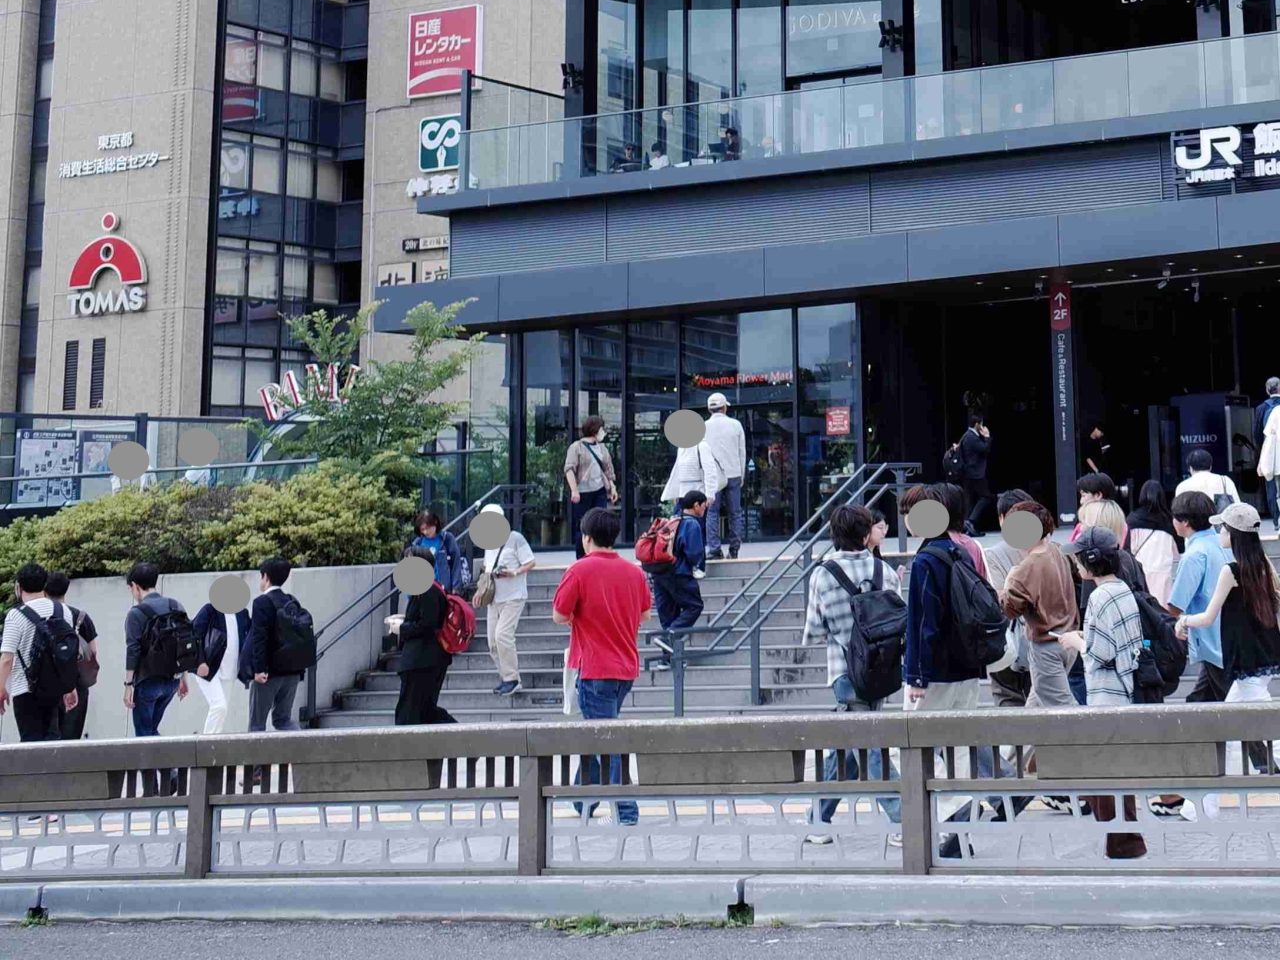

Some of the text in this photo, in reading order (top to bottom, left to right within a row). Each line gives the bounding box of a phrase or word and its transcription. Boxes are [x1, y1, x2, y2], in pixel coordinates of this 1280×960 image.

[415, 18, 441, 38] 日産
[414, 35, 471, 57] レンタカー
[97, 131, 133, 151] 東京都
[1175, 126, 1244, 170] JR
[58, 152, 171, 178] 消費生活総合センター
[67, 287, 146, 316] TOMAS
[1053, 309, 1068, 320] 2F
[698, 376, 735, 386] Aoyama
[737, 372, 770, 383] Flower
[1180, 434, 1217, 444] MIZUHO
